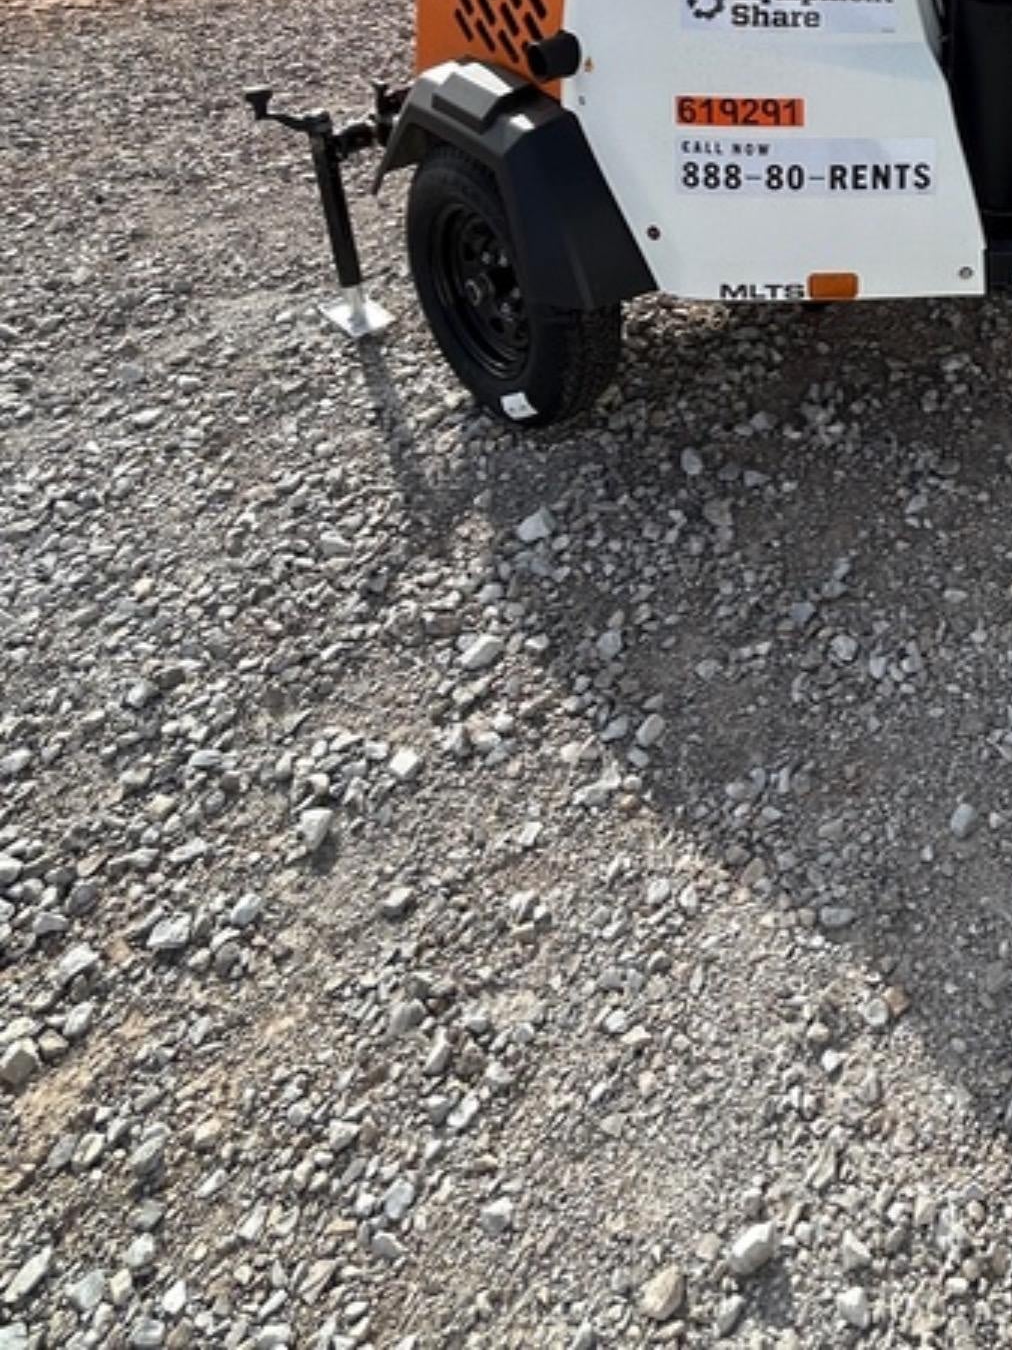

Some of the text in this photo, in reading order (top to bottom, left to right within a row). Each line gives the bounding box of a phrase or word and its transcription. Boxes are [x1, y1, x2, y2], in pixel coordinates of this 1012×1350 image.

[730, 4, 821, 28] Share
[677, 96, 800, 125] 619291
[681, 140, 771, 156] CALL NOW
[681, 161, 931, 191] 888-80-RENTS
[720, 283, 806, 299] MLTS
